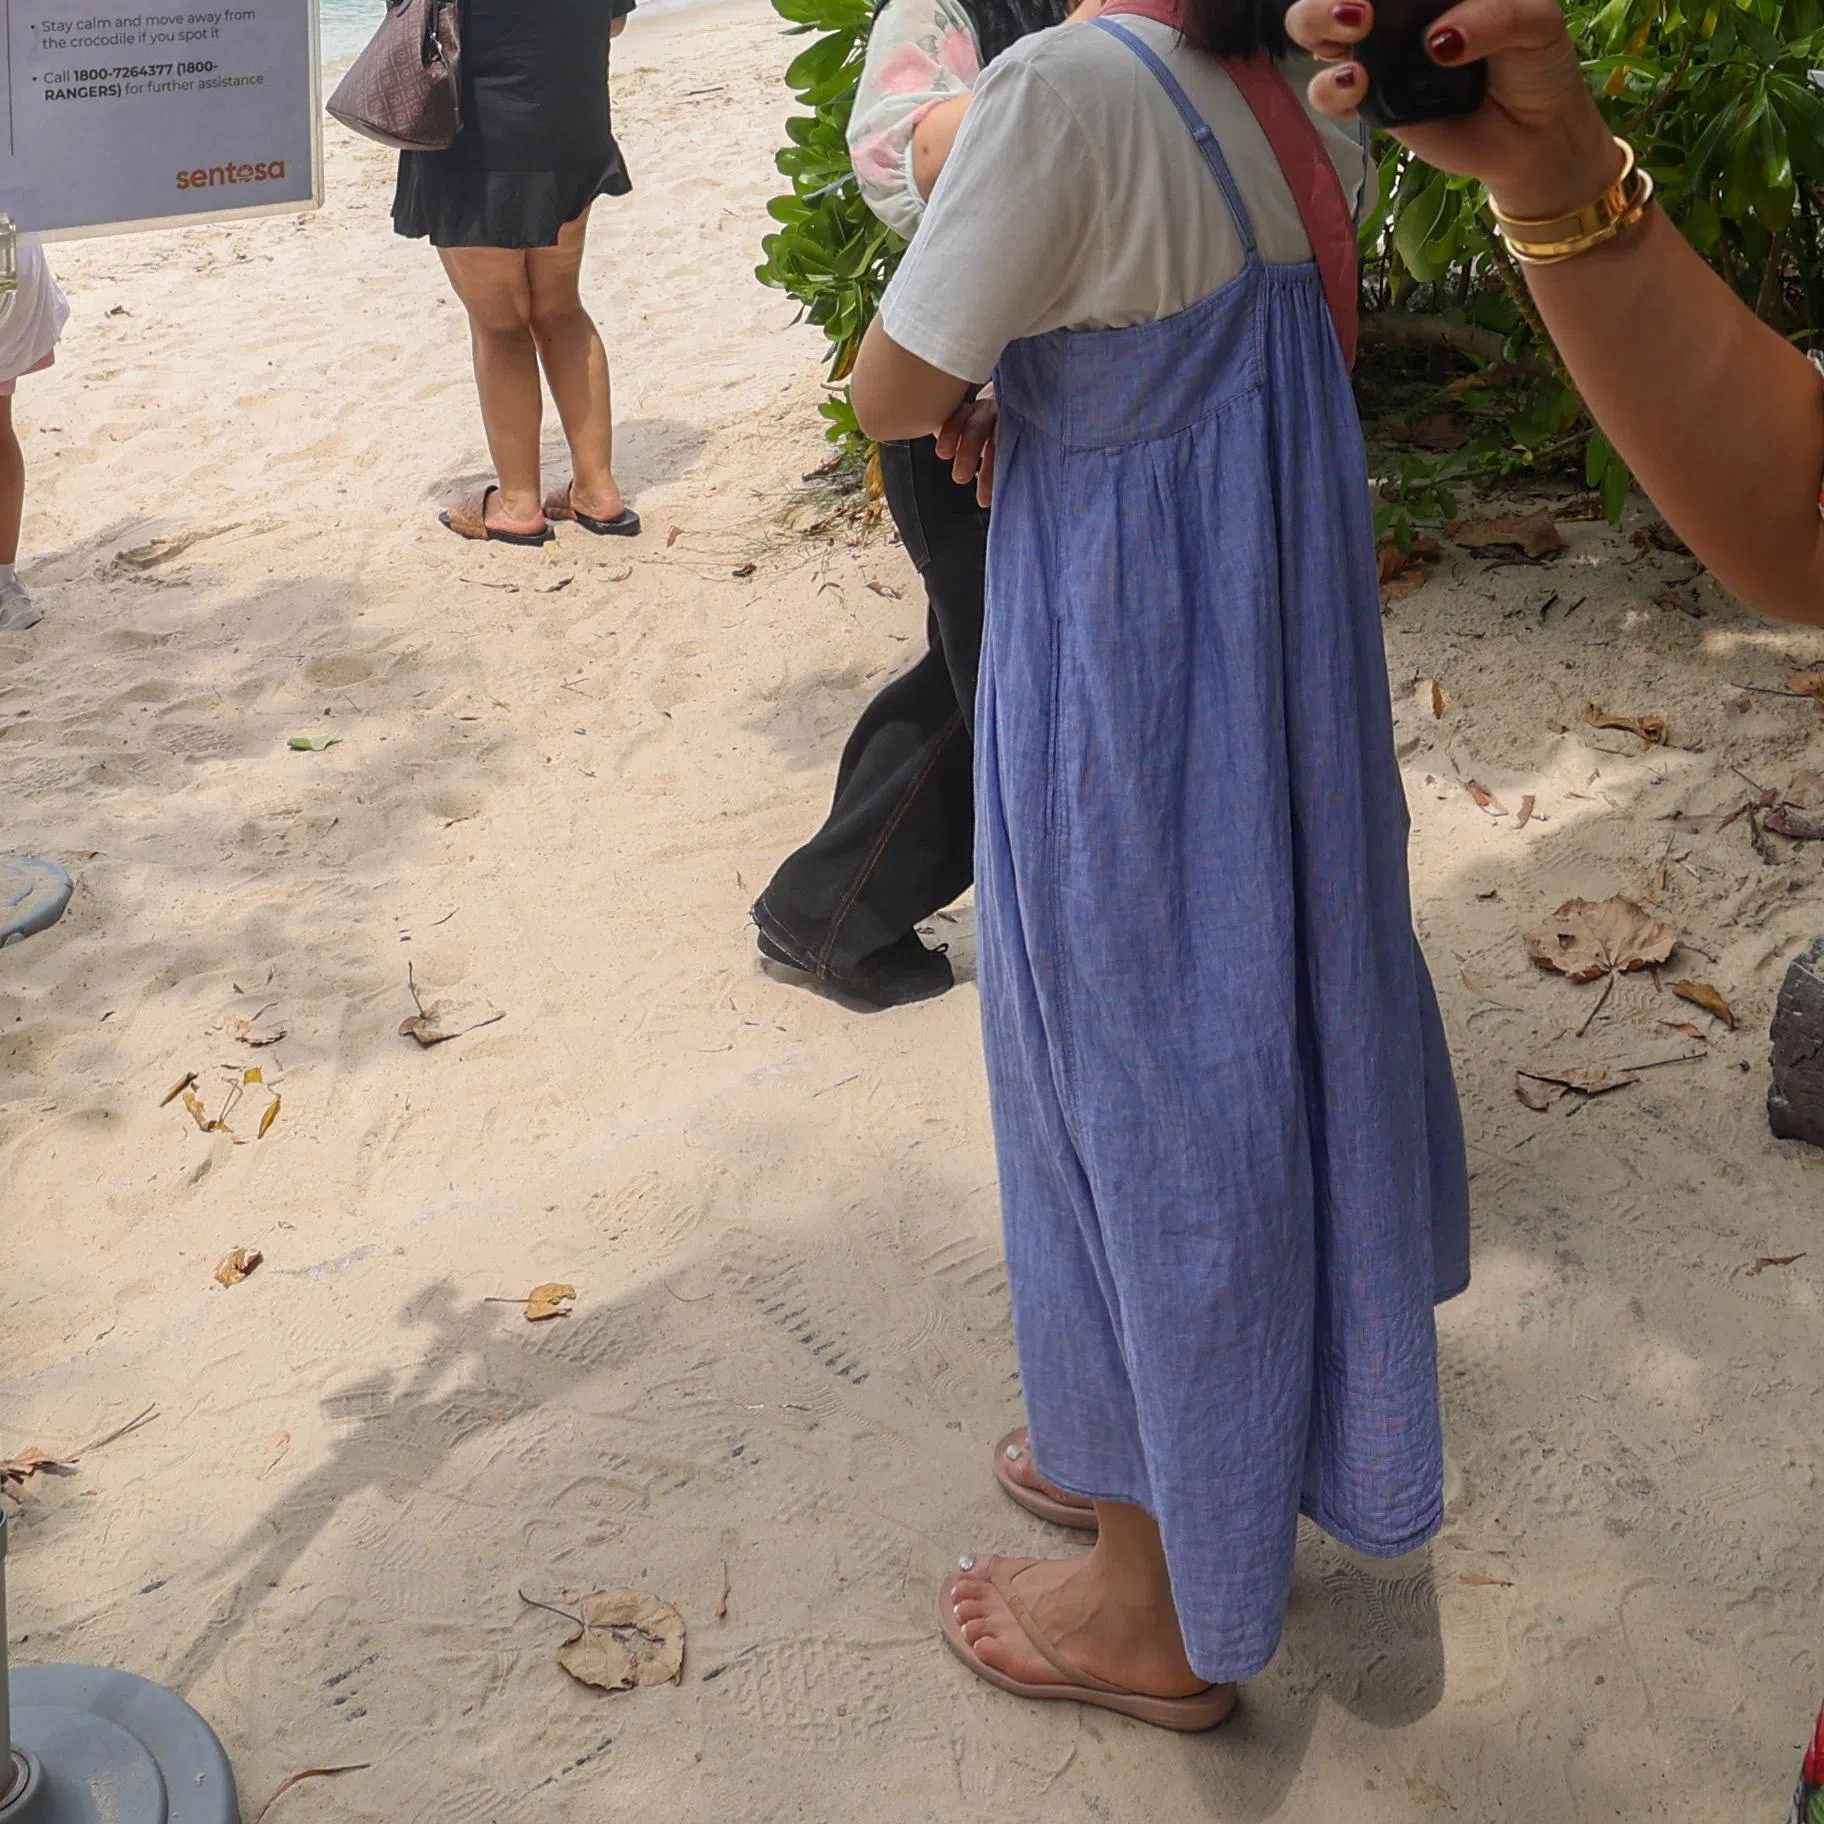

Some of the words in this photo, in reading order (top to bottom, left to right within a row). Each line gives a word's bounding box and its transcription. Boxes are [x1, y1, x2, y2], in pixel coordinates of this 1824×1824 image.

[42, 20, 73, 34] Stay
[76, 17, 111, 30] calm
[115, 15, 141, 28] and
[145, 15, 184, 26] move
[187, 13, 222, 25] away
[224, 8, 256, 21] from
[42, 37, 67, 49] the
[70, 32, 135, 48] crocodile
[138, 30, 147, 43] if
[149, 32, 175, 46] you
[178, 29, 207, 43] spot
[211, 27, 220, 39] it
[43, 70, 70, 84] Call
[73, 64, 173, 82] 1800-7264377
[177, 61, 218, 77] (1800-
[45, 84, 122, 101] RANGERS)
[125, 82, 144, 95] for
[147, 79, 194, 93] further
[198, 75, 264, 90] assistance
[176, 160, 285, 190] sentosa
